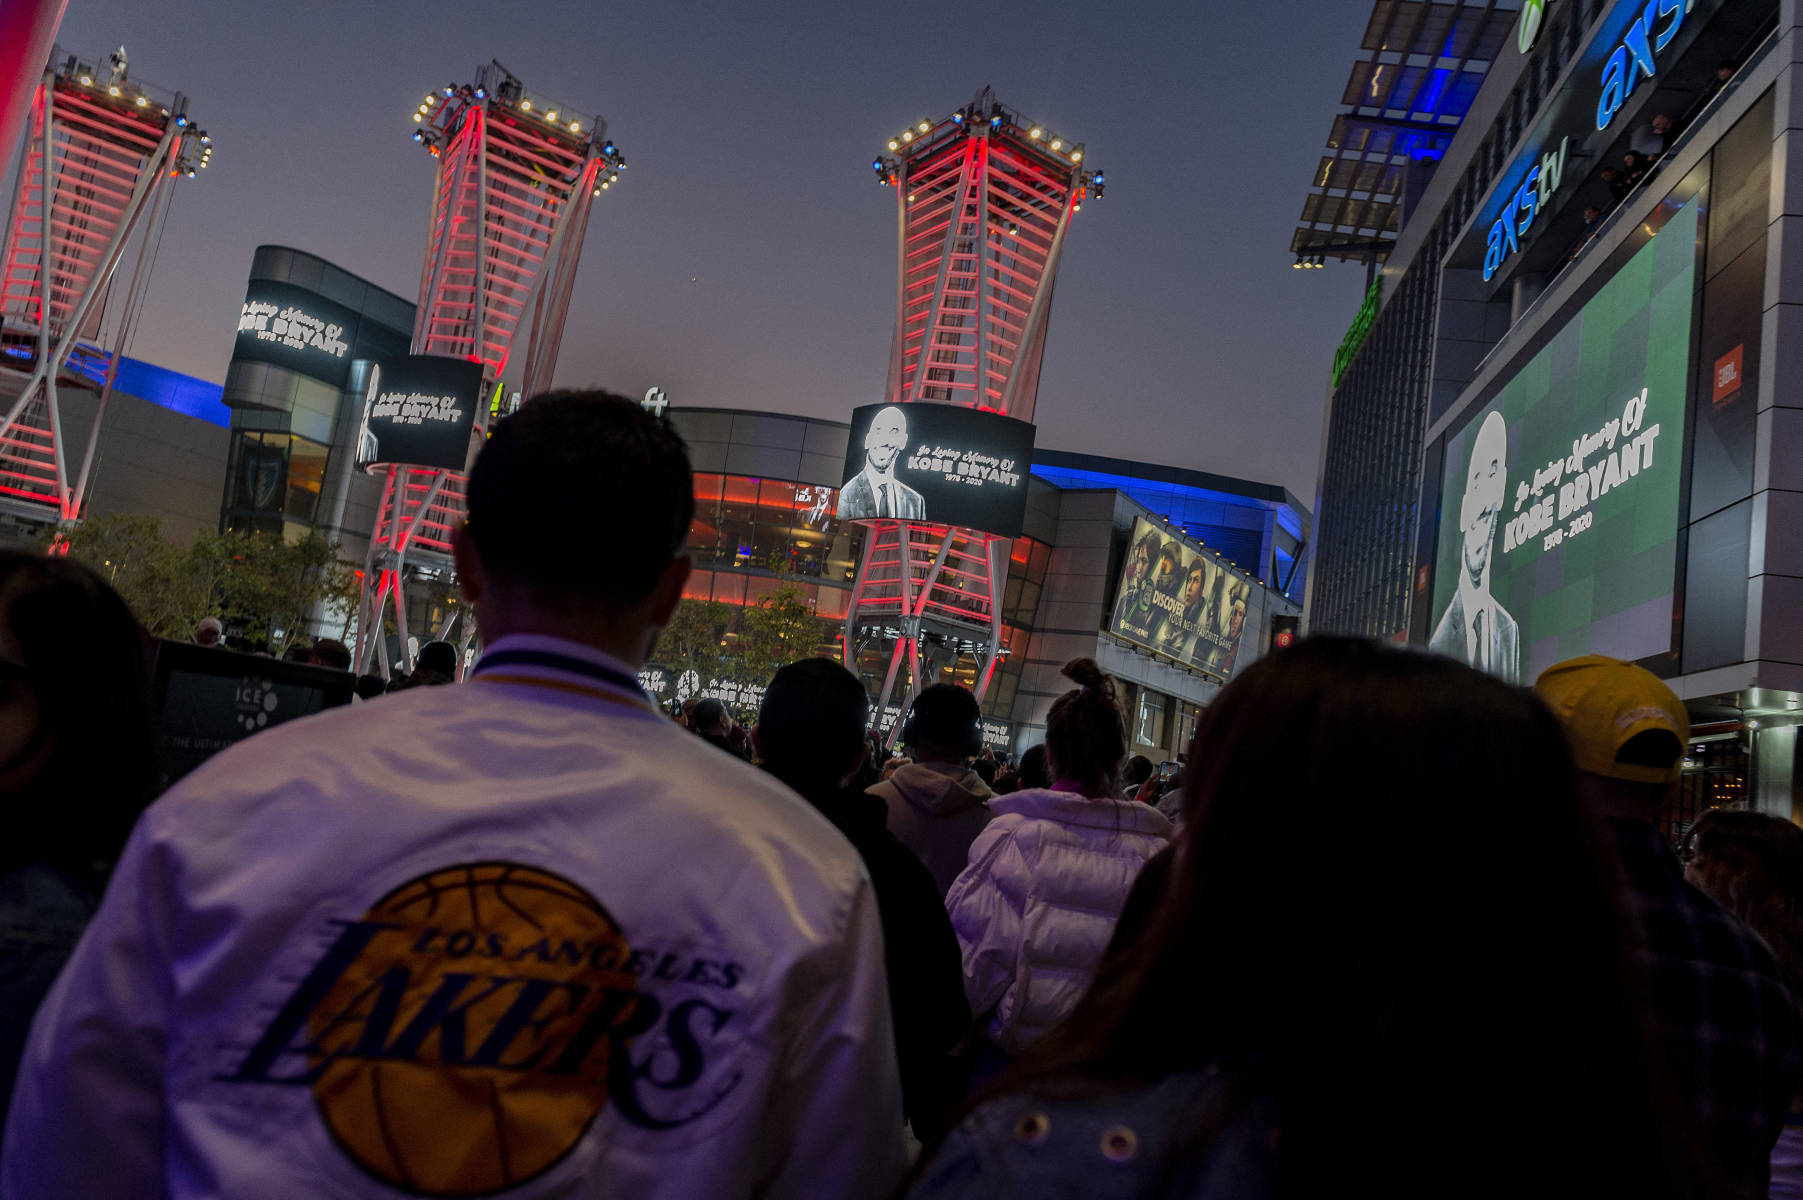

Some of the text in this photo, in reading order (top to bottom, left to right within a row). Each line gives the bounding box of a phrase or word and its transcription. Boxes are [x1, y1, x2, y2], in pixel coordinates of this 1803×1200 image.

[272, 317, 348, 358] BRYANT
[1718, 361, 1737, 388] JBL
[401, 403, 462, 423] BRYANT
[1621, 387, 1648, 437] Of
[907, 456, 1019, 487] KOBE BRYANT
[1000, 458, 1015, 472] Of
[945, 473, 983, 486] 1978 2020
[1503, 423, 1660, 554] KOBE BRYANT
[1568, 511, 1593, 538] 2020
[1152, 589, 1185, 617] DISCOVER
[1168, 612, 1233, 651] YOUR NEXT FAVORITE GAME
[235, 687, 262, 705] ICE
[194, 738, 232, 750] ULTIMA
[412, 928, 744, 990] LOS ANGELES
[213, 920, 744, 1130] LAKERS
